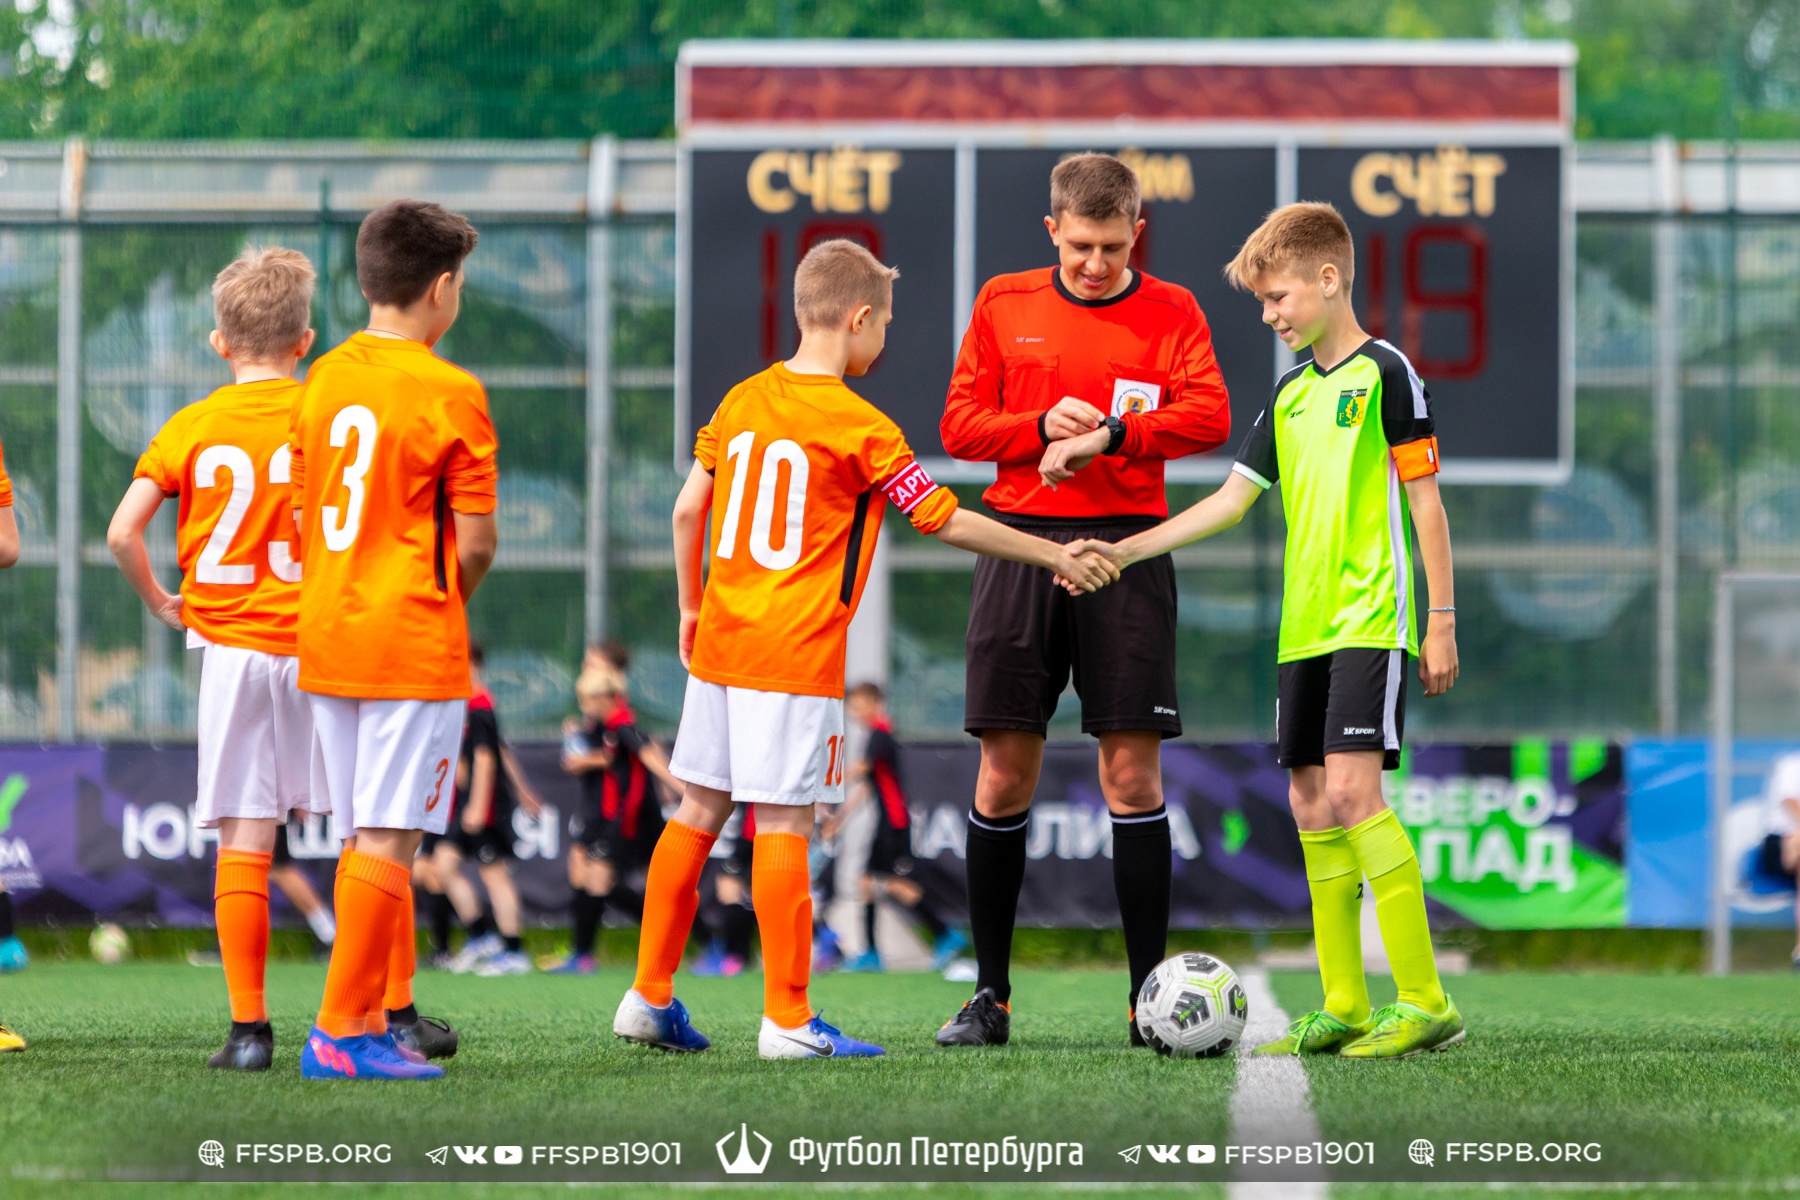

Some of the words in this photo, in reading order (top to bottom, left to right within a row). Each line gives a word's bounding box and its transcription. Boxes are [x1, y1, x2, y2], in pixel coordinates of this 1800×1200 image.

[747, 144, 902, 213] СЧЁТ
[1351, 146, 1506, 216] СЧЁТ
[321, 405, 378, 552] 3
[716, 430, 810, 571] 10
[425, 757, 449, 813] 3
